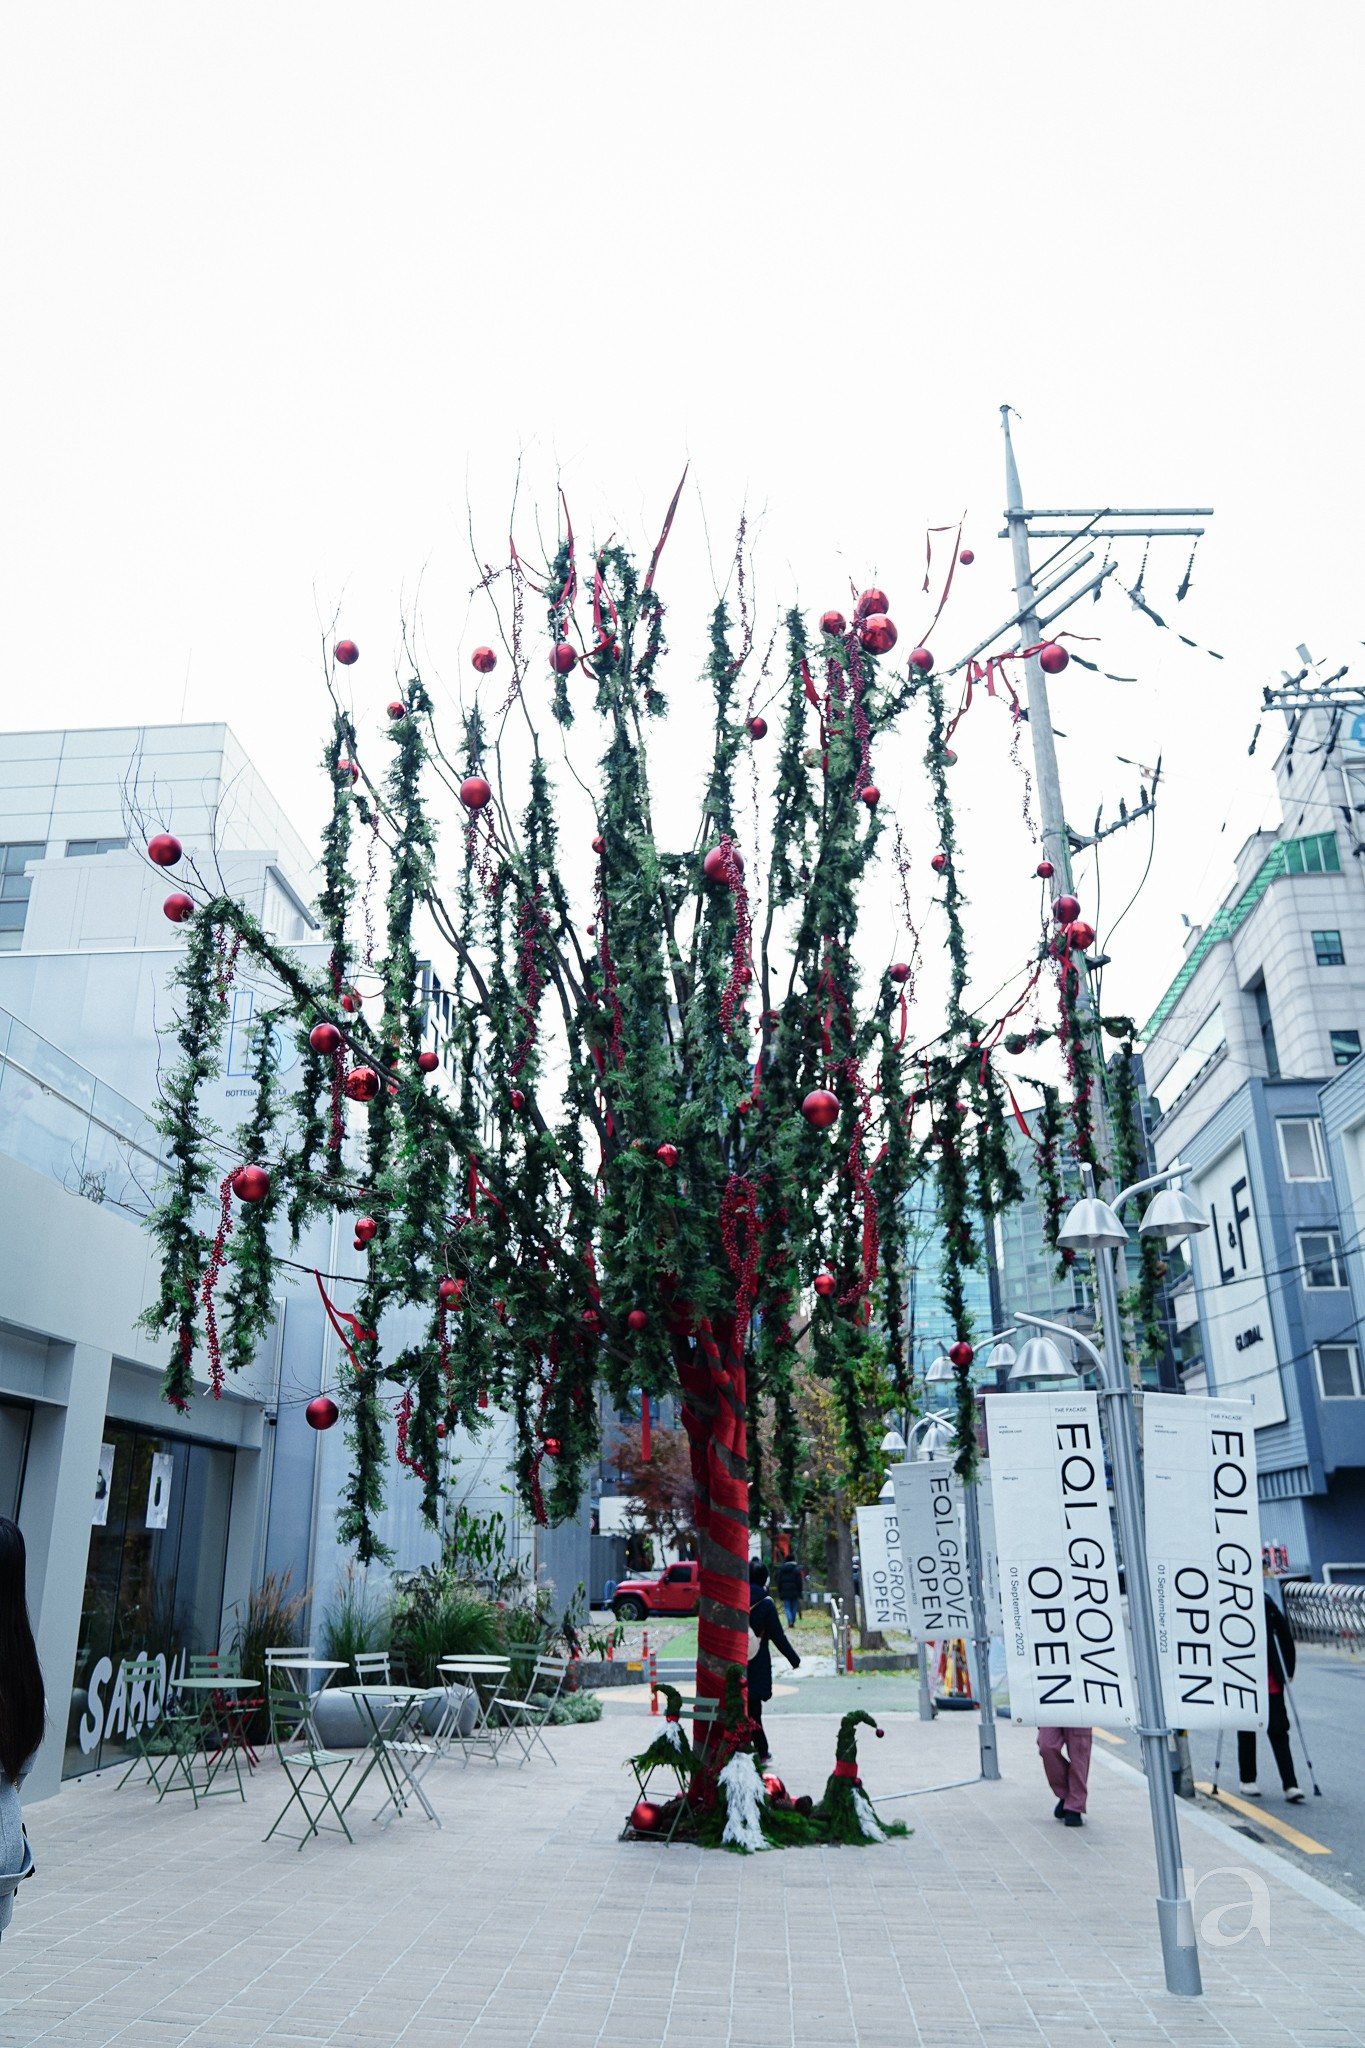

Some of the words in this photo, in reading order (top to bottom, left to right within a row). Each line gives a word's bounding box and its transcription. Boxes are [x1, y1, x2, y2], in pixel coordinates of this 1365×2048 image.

[225, 1089, 257, 1097] BOTTEGA
[1211, 1175, 1250, 1285] L&F
[917, 1556, 944, 1630] OPEN
[1010, 1567, 1018, 1576] 01
[1157, 1565, 1165, 1573] 01
[872, 1570, 890, 1623] OPEN
[1011, 1580, 1021, 1630] September
[1157, 1578, 1167, 1627] September
[1016, 1633, 1025, 1656] 2023
[1028, 1566, 1074, 1705] OPEN
[1160, 1630, 1168, 1653] 2023
[1174, 1567, 1215, 1705] OPEN
